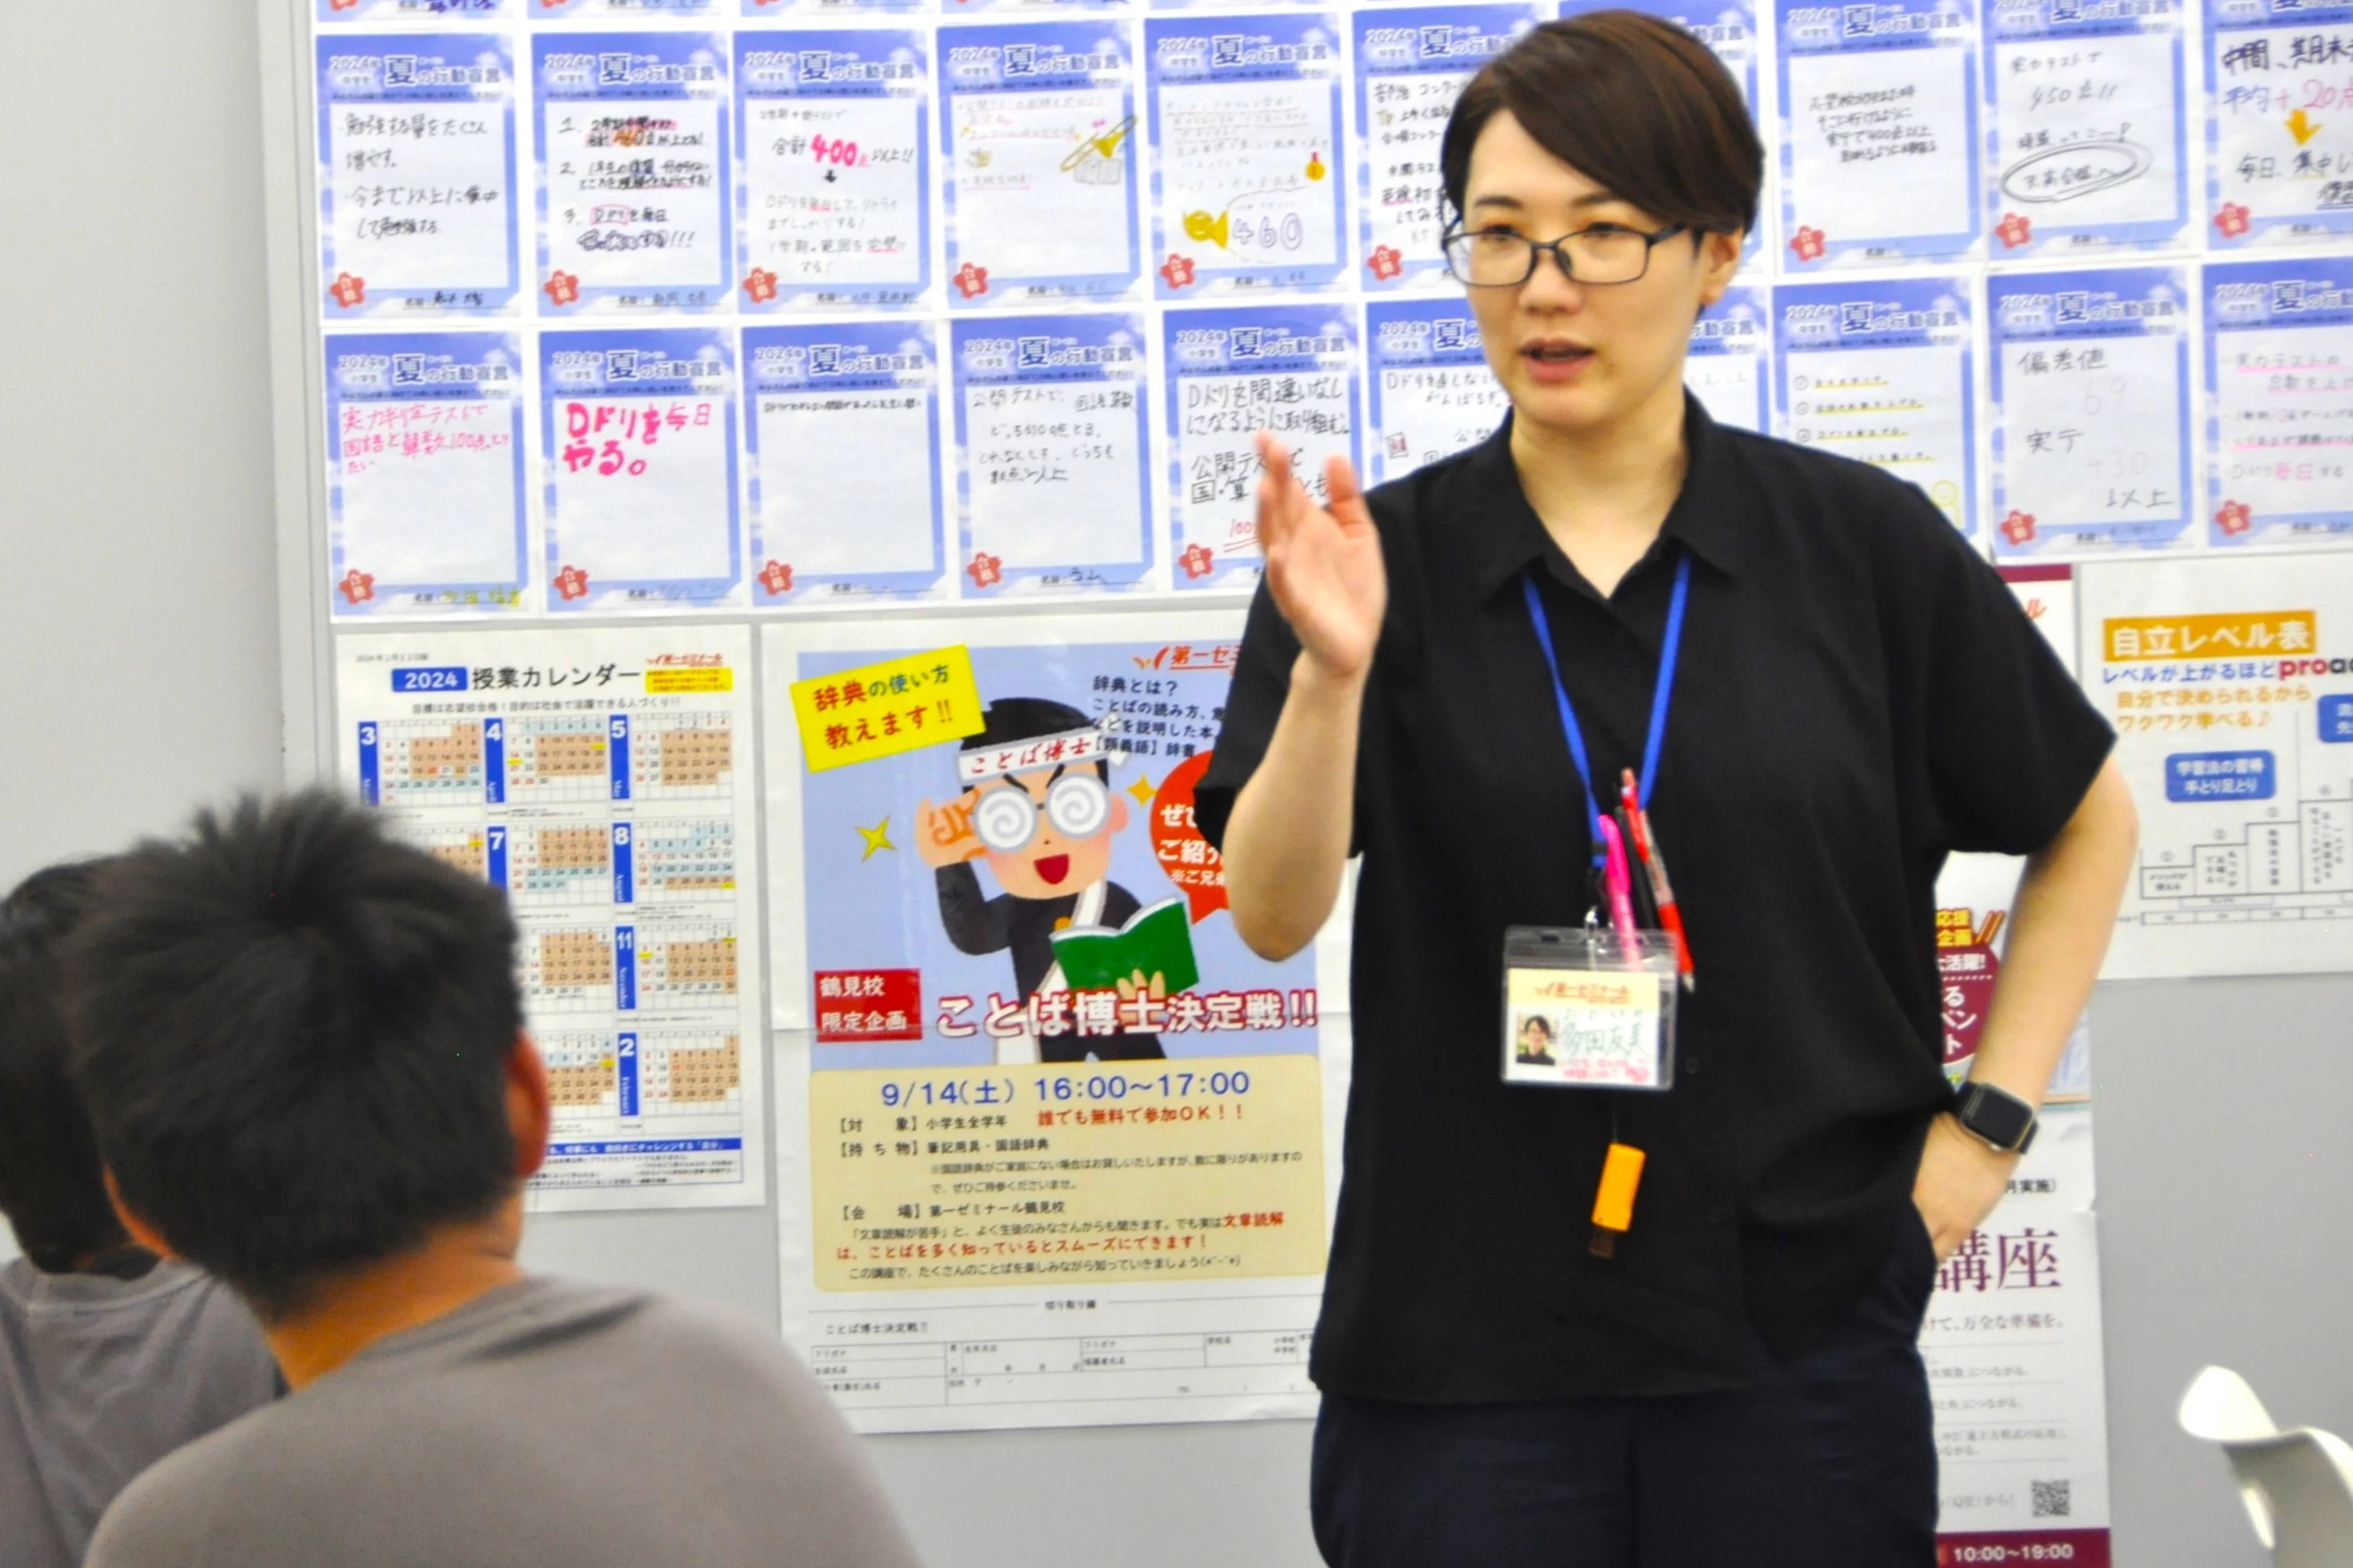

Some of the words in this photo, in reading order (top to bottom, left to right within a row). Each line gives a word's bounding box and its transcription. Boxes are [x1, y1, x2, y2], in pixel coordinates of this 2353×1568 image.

[1233, 213, 1303, 251] 460
[563, 439, 647, 476] やる。
[2112, 620, 2310, 658] 自立レベル表
[405, 672, 458, 689] 2024
[471, 664, 641, 691] 授業カレンダー
[813, 663, 950, 713] 辞典の使い方
[1092, 675, 1178, 696] 辞典とは?
[2117, 685, 2312, 709] 自分で決められるから
[361, 726, 376, 745] 3
[487, 723, 501, 741] 4
[611, 721, 626, 739] 5
[824, 699, 955, 750] 教えます!!
[971, 735, 1092, 776] ことば博士
[489, 833, 505, 850] 7
[615, 828, 629, 845] 8
[617, 931, 633, 950] 11
[820, 975, 885, 998] 鶴見校
[821, 1011, 908, 1032] 限定企画
[936, 987, 1320, 1038] ことば博士決定戦!!
[619, 1038, 635, 1057] 2
